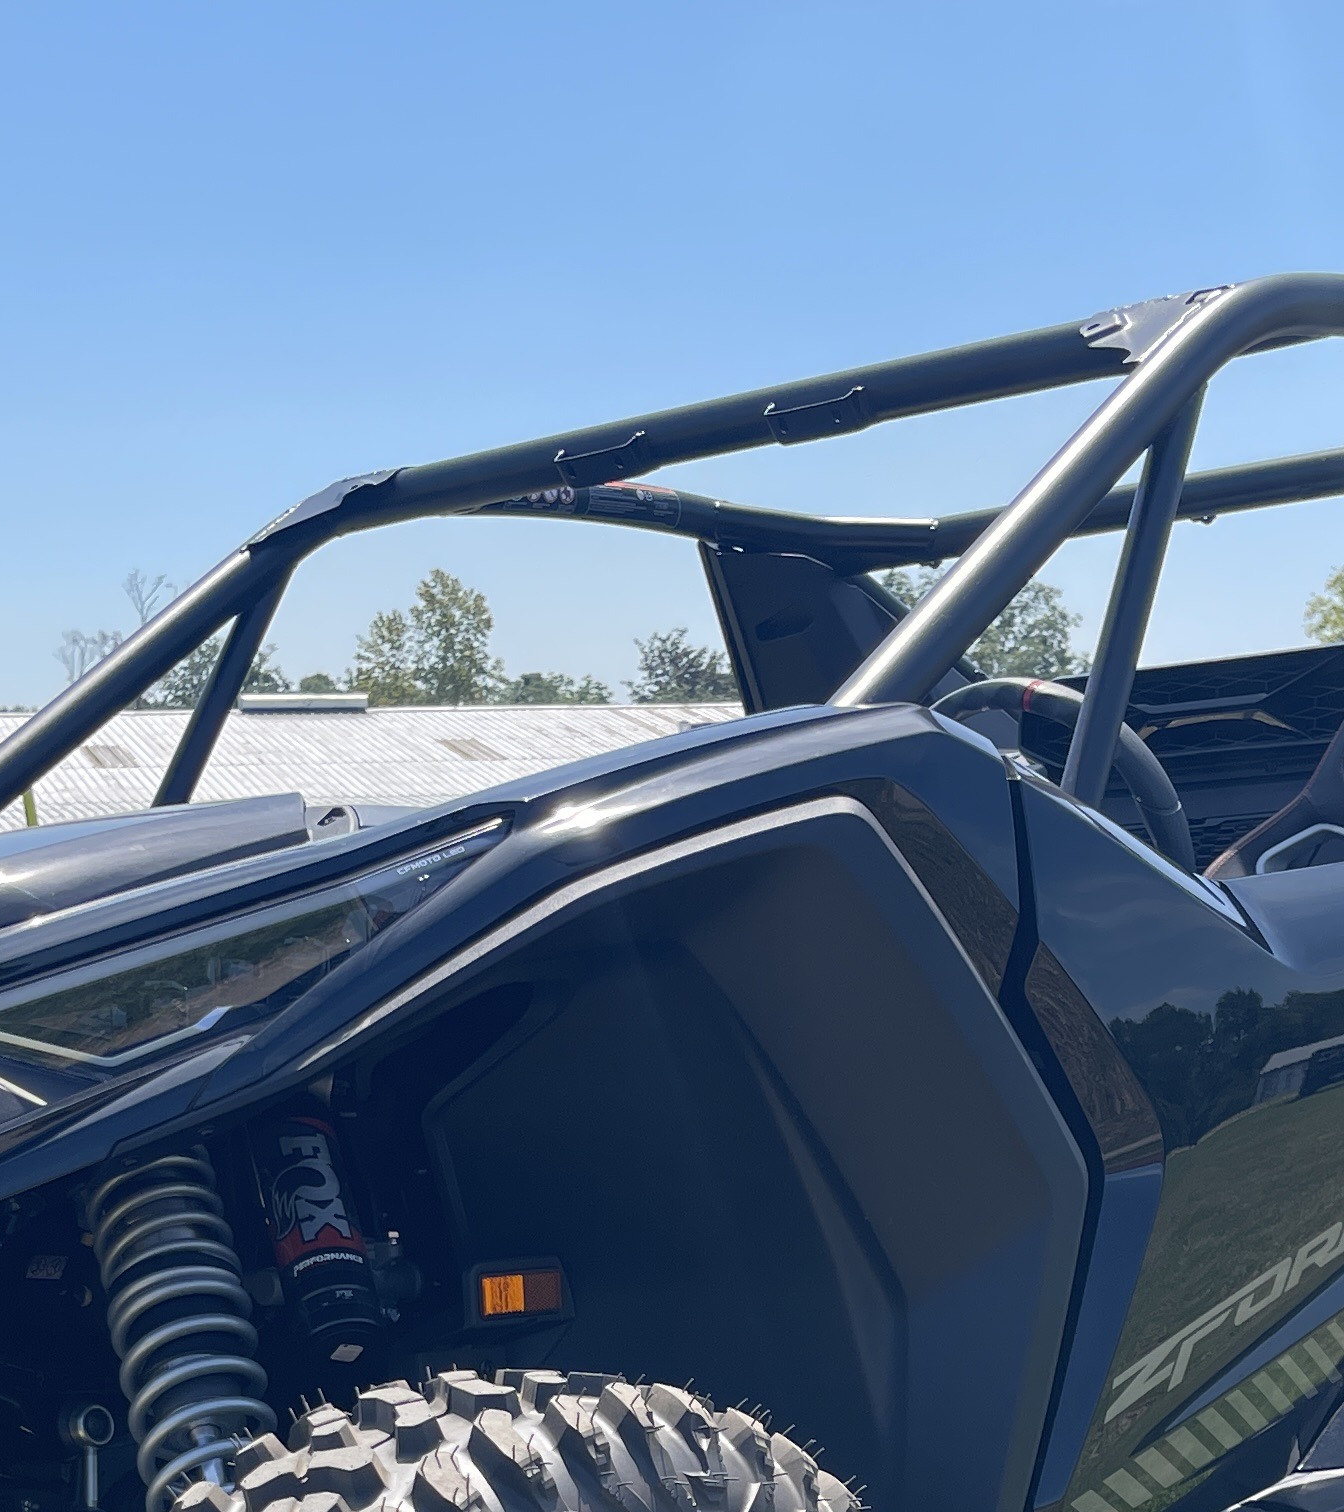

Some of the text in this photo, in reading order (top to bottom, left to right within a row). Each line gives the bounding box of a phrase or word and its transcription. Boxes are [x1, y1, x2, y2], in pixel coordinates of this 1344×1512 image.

[396, 854, 442, 876] CFMOTO
[273, 1133, 352, 1242] FOX
[293, 1252, 364, 1278] PERFORMANCE
